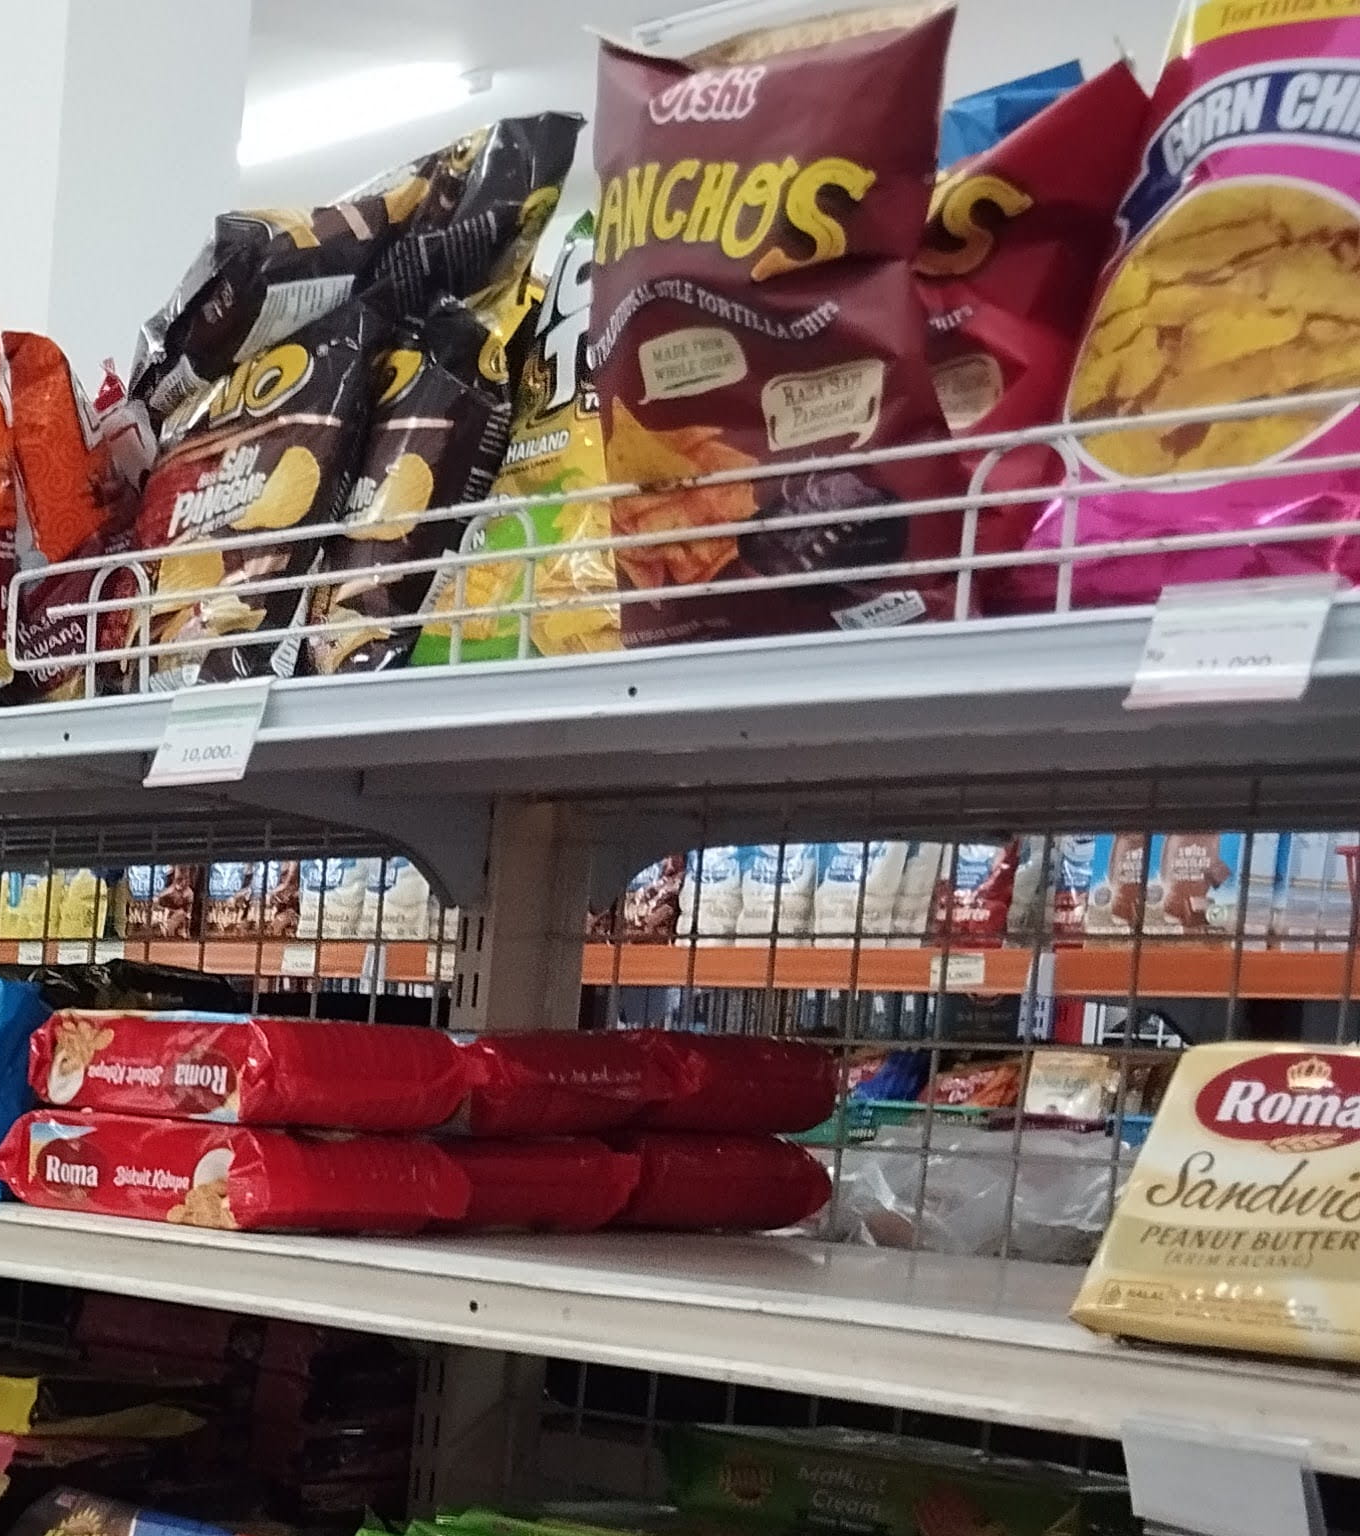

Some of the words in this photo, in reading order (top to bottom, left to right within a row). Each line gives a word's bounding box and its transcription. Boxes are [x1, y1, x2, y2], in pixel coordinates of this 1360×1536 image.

[1161, 76, 1272, 178] CORN
[1276, 71, 1360, 138] CHI
[696, 286, 791, 339] TORTILLA
[20, 621, 87, 662] awang
[174, 1064, 229, 1096] Roma
[1216, 1080, 1360, 1128] Roma
[45, 1154, 99, 1188] Roma
[1146, 1150, 1360, 1223] Sandwic
[1140, 1225, 1244, 1251] PEANUT
[1248, 1227, 1360, 1251] BUTTER
